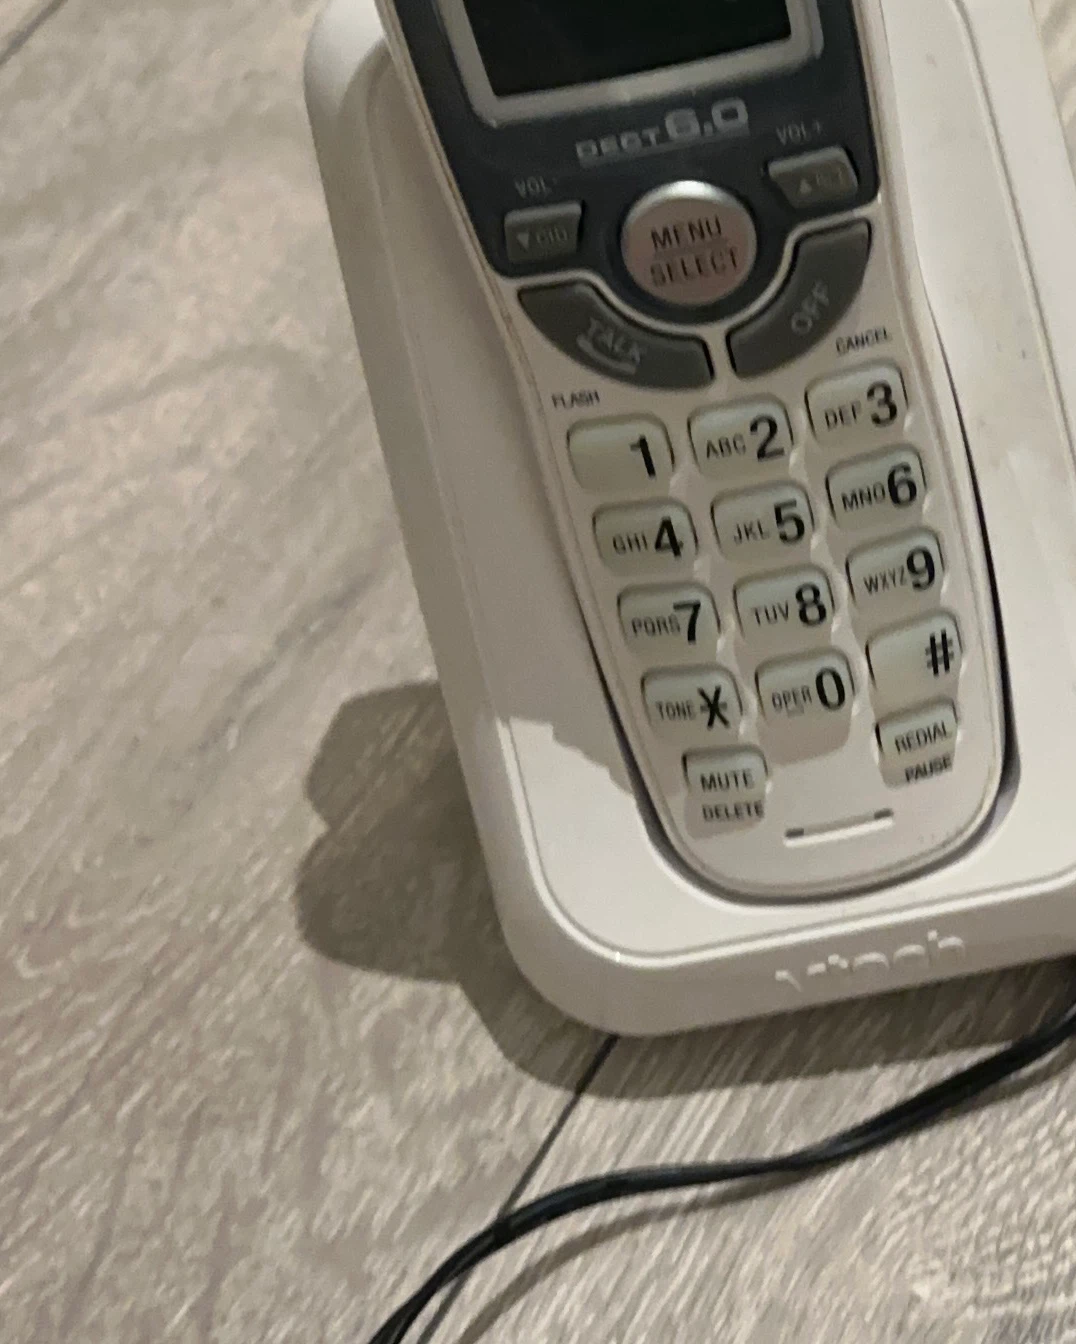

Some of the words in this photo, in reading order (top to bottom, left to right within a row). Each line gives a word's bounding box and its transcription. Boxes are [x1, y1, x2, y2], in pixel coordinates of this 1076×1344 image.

[650, 216, 722, 251] MENU
[649, 249, 740, 287] SELECT
[835, 327, 891, 353] CANCEL
[551, 390, 600, 410] FLASH
[867, 381, 898, 427] 3
[630, 434, 657, 479] 1
[706, 434, 746, 459] ABC
[749, 415, 785, 462] 2
[842, 485, 886, 511] MNO
[887, 462, 918, 508] 6
[612, 530, 648, 554] GHI
[654, 516, 683, 558] 4
[733, 519, 769, 544] JKL
[774, 500, 805, 544] 5
[906, 546, 936, 590] 9
[673, 600, 702, 644] 7
[752, 600, 789, 626] TUV
[795, 583, 827, 627] 8
[655, 693, 696, 720] TONE
[772, 685, 812, 711] OPER
[815, 667, 847, 711] 0
[895, 722, 951, 754] REDIAL
[700, 768, 754, 793] MUTE
[905, 757, 953, 784] PAUSE
[702, 799, 764, 821] DELETE
